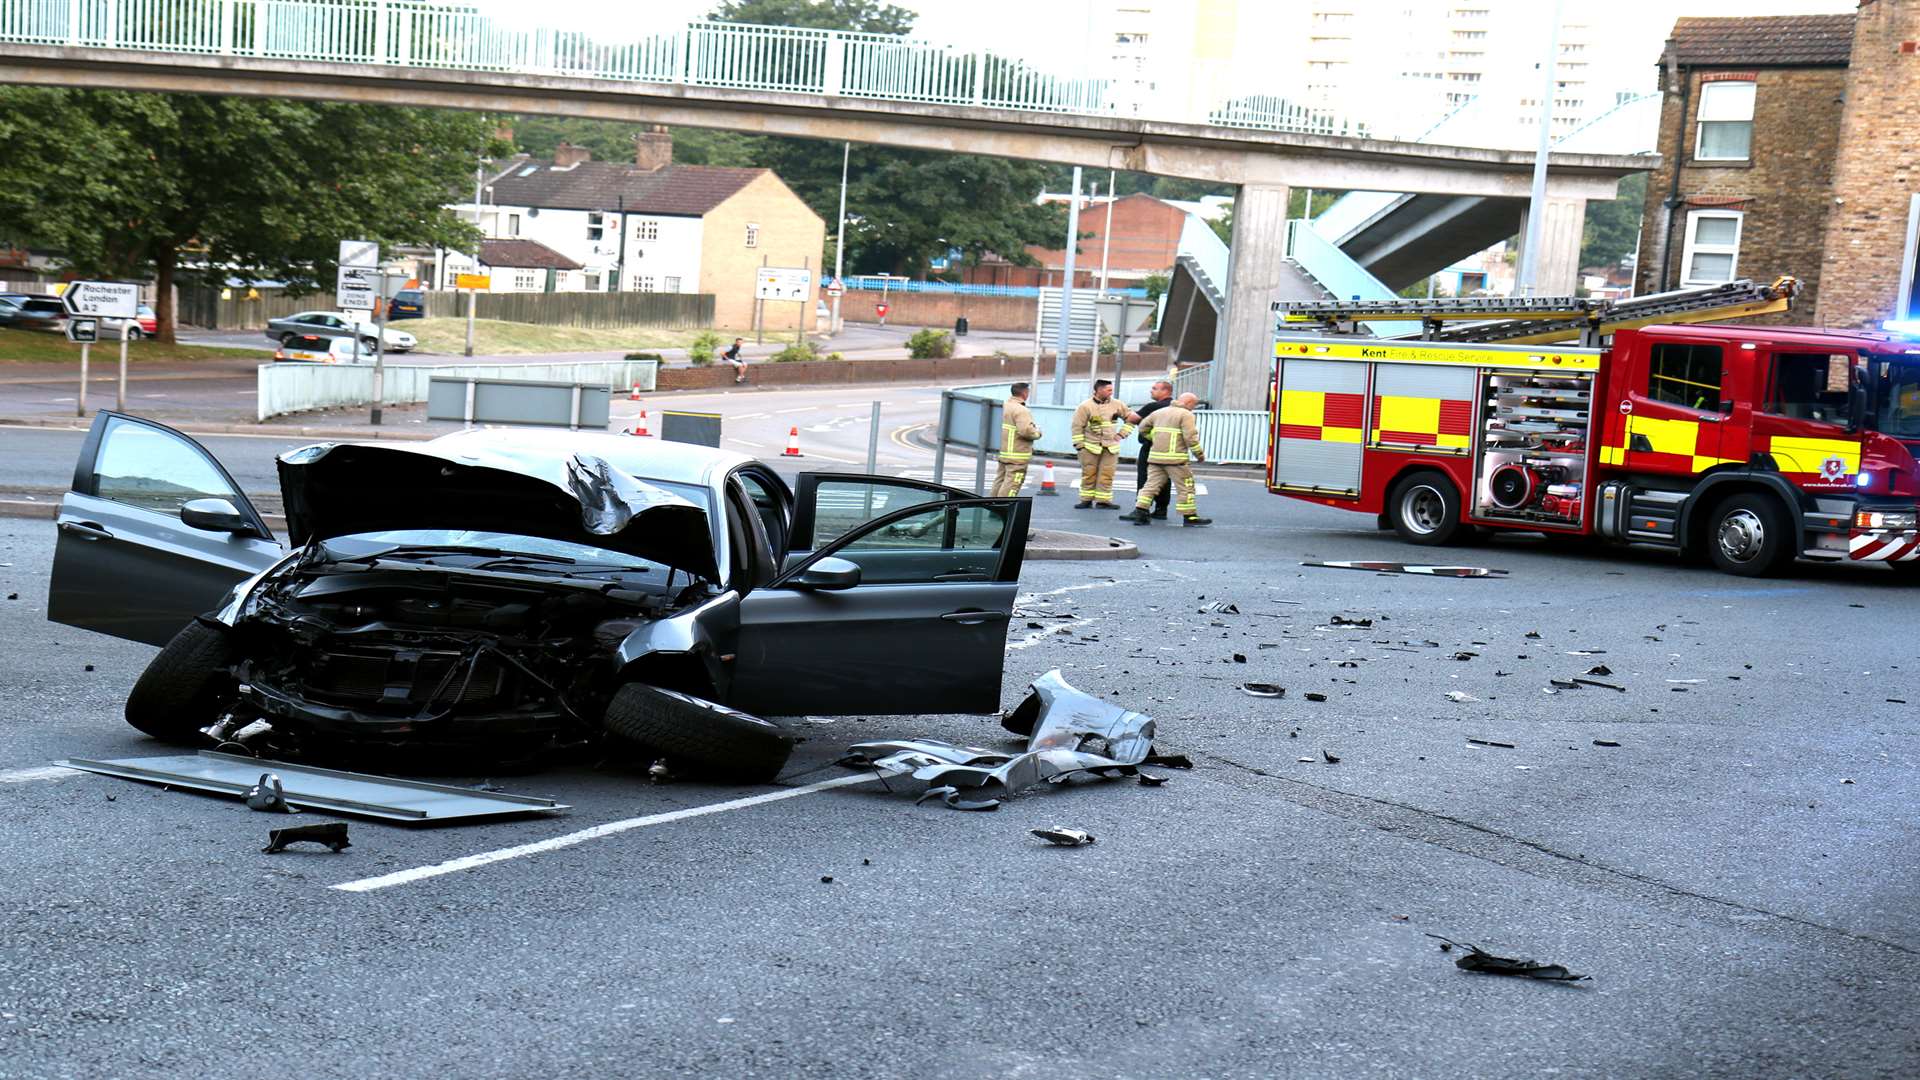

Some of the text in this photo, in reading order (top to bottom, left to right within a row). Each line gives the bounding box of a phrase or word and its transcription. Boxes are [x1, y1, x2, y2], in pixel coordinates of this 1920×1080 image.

[83, 284, 131, 295] Rochester
[83, 294, 118, 303] London
[1361, 348, 1494, 362] Kent Fire & Rescue Service
